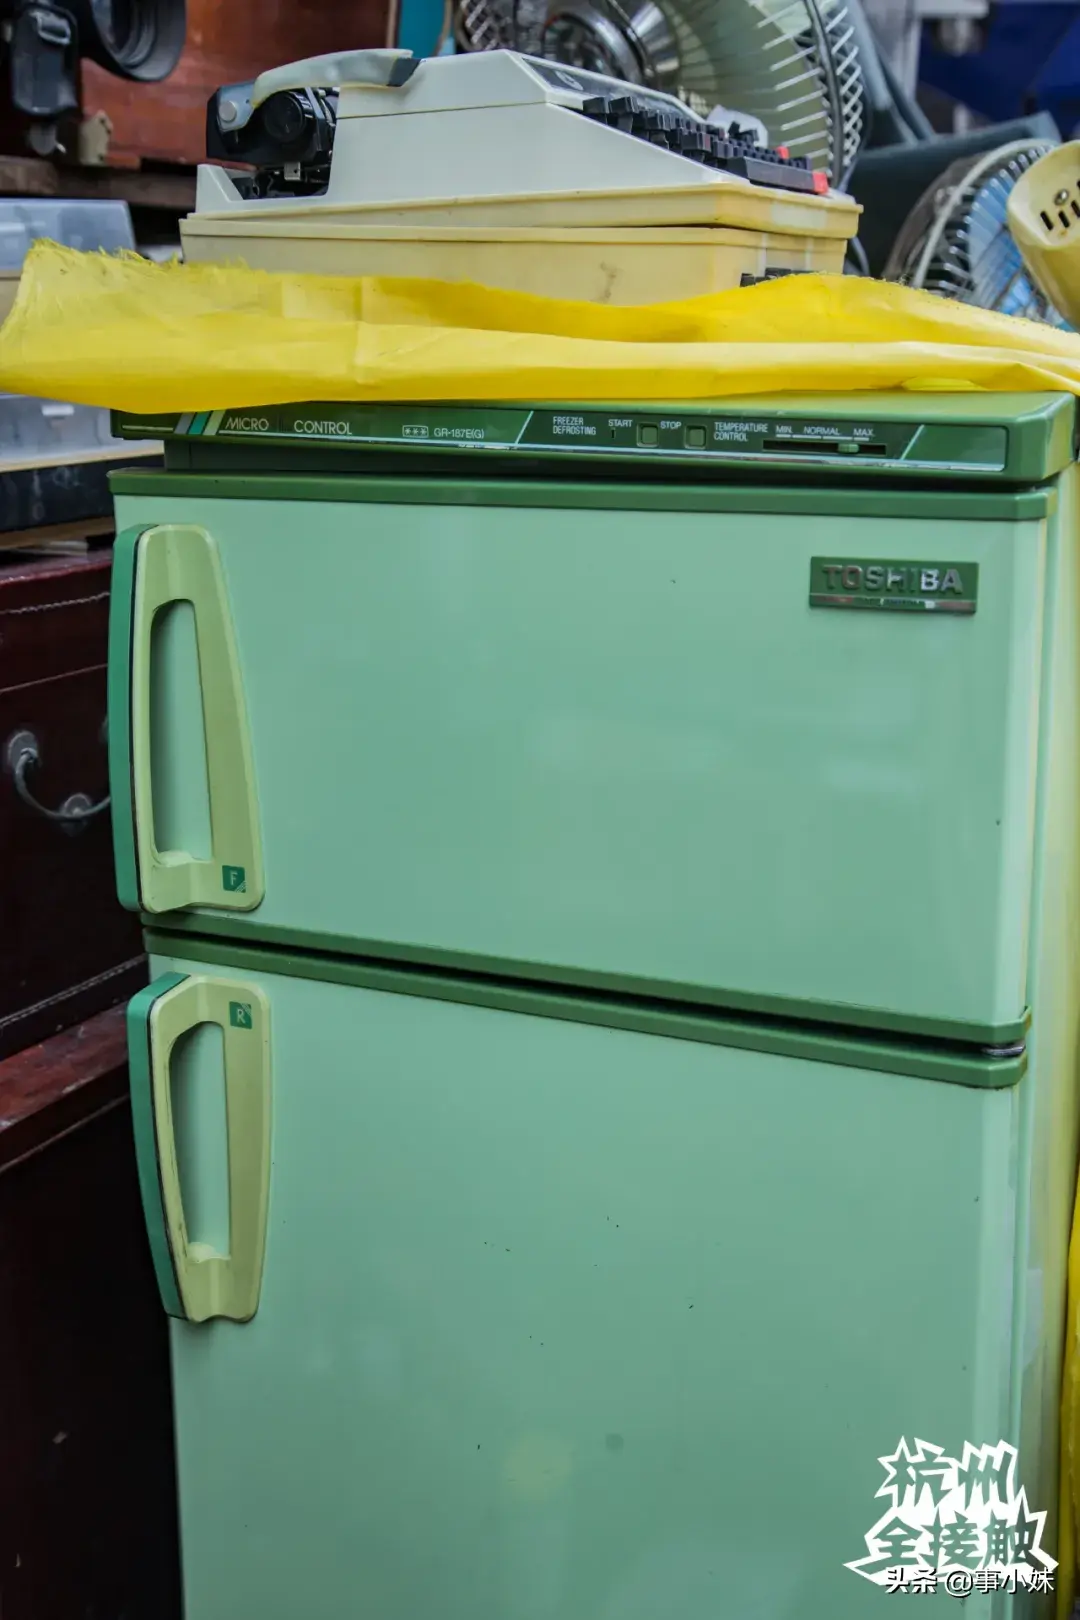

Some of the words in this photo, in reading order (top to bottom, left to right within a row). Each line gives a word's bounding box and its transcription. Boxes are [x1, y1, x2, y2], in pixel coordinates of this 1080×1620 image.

[552, 416, 584, 426] FREEZER
[607, 419, 633, 428] START
[660, 421, 682, 430] STOP
[225, 417, 270, 432] MICRO
[293, 420, 353, 436] CONTROL
[552, 425, 596, 435] DEFROSTING
[714, 422, 769, 433] TEMPERATURE
[803, 426, 840, 436] NORMAL
[713, 432, 748, 442] CONTROL
[822, 564, 963, 594] TOSHIBA
[229, 870, 238, 886] F
[236, 1008, 246, 1024] R
